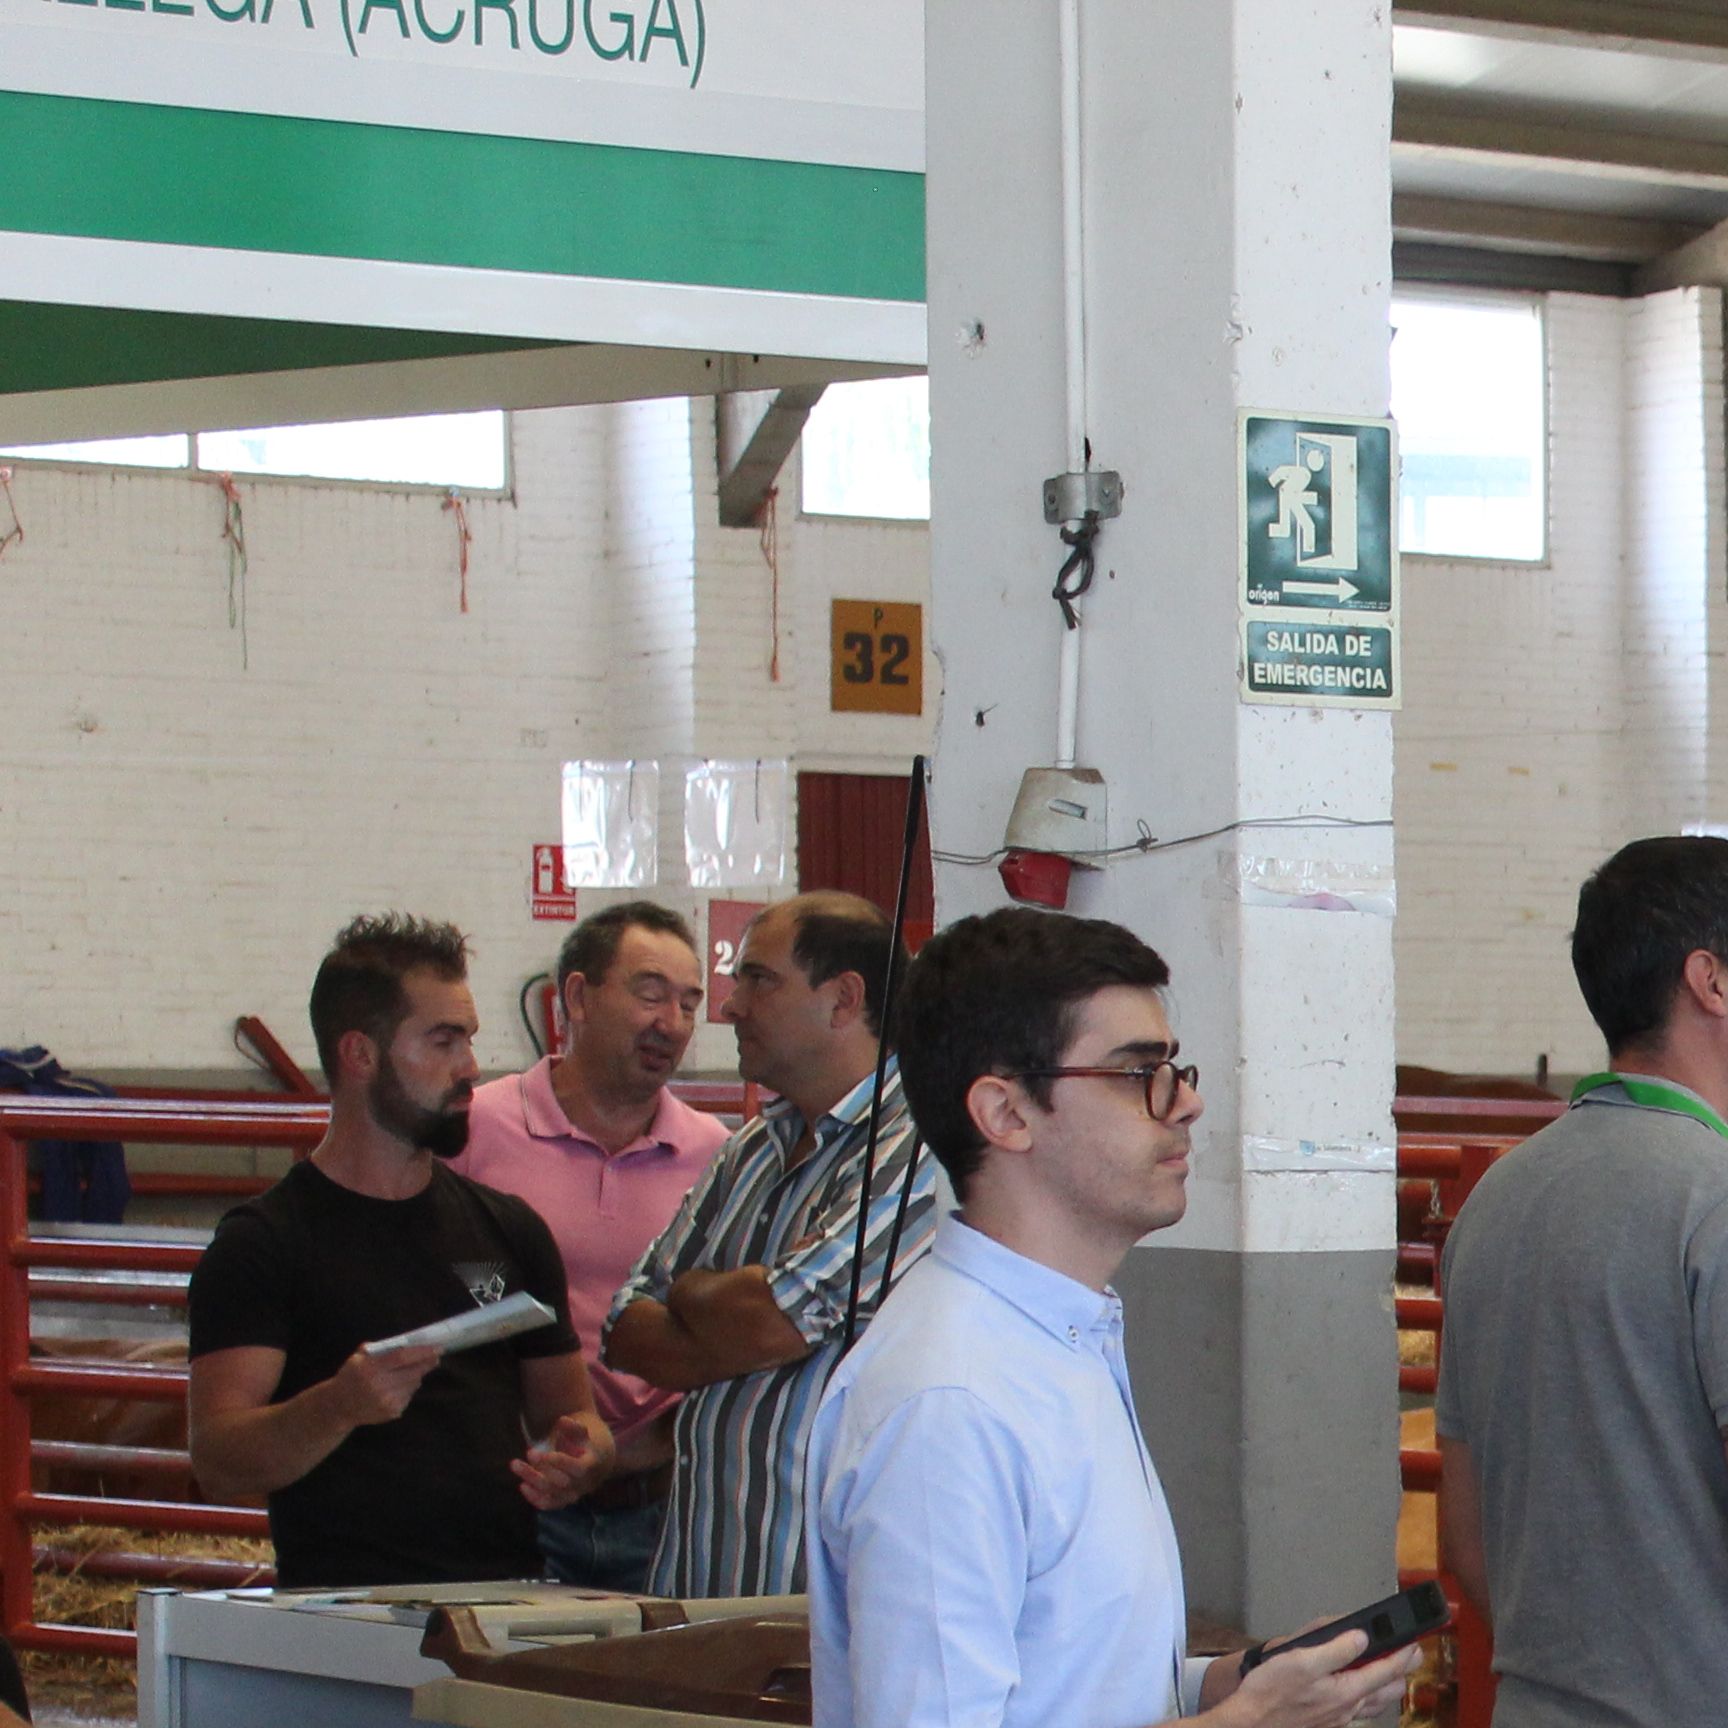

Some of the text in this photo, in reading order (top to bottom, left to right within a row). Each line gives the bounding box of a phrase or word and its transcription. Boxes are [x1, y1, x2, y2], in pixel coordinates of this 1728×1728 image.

[1248, 583, 1280, 605] origen
[1266, 630, 1373, 657] SALIDA DE
[843, 632, 910, 685] 32
[1253, 662, 1388, 690] EMERGENCIA
